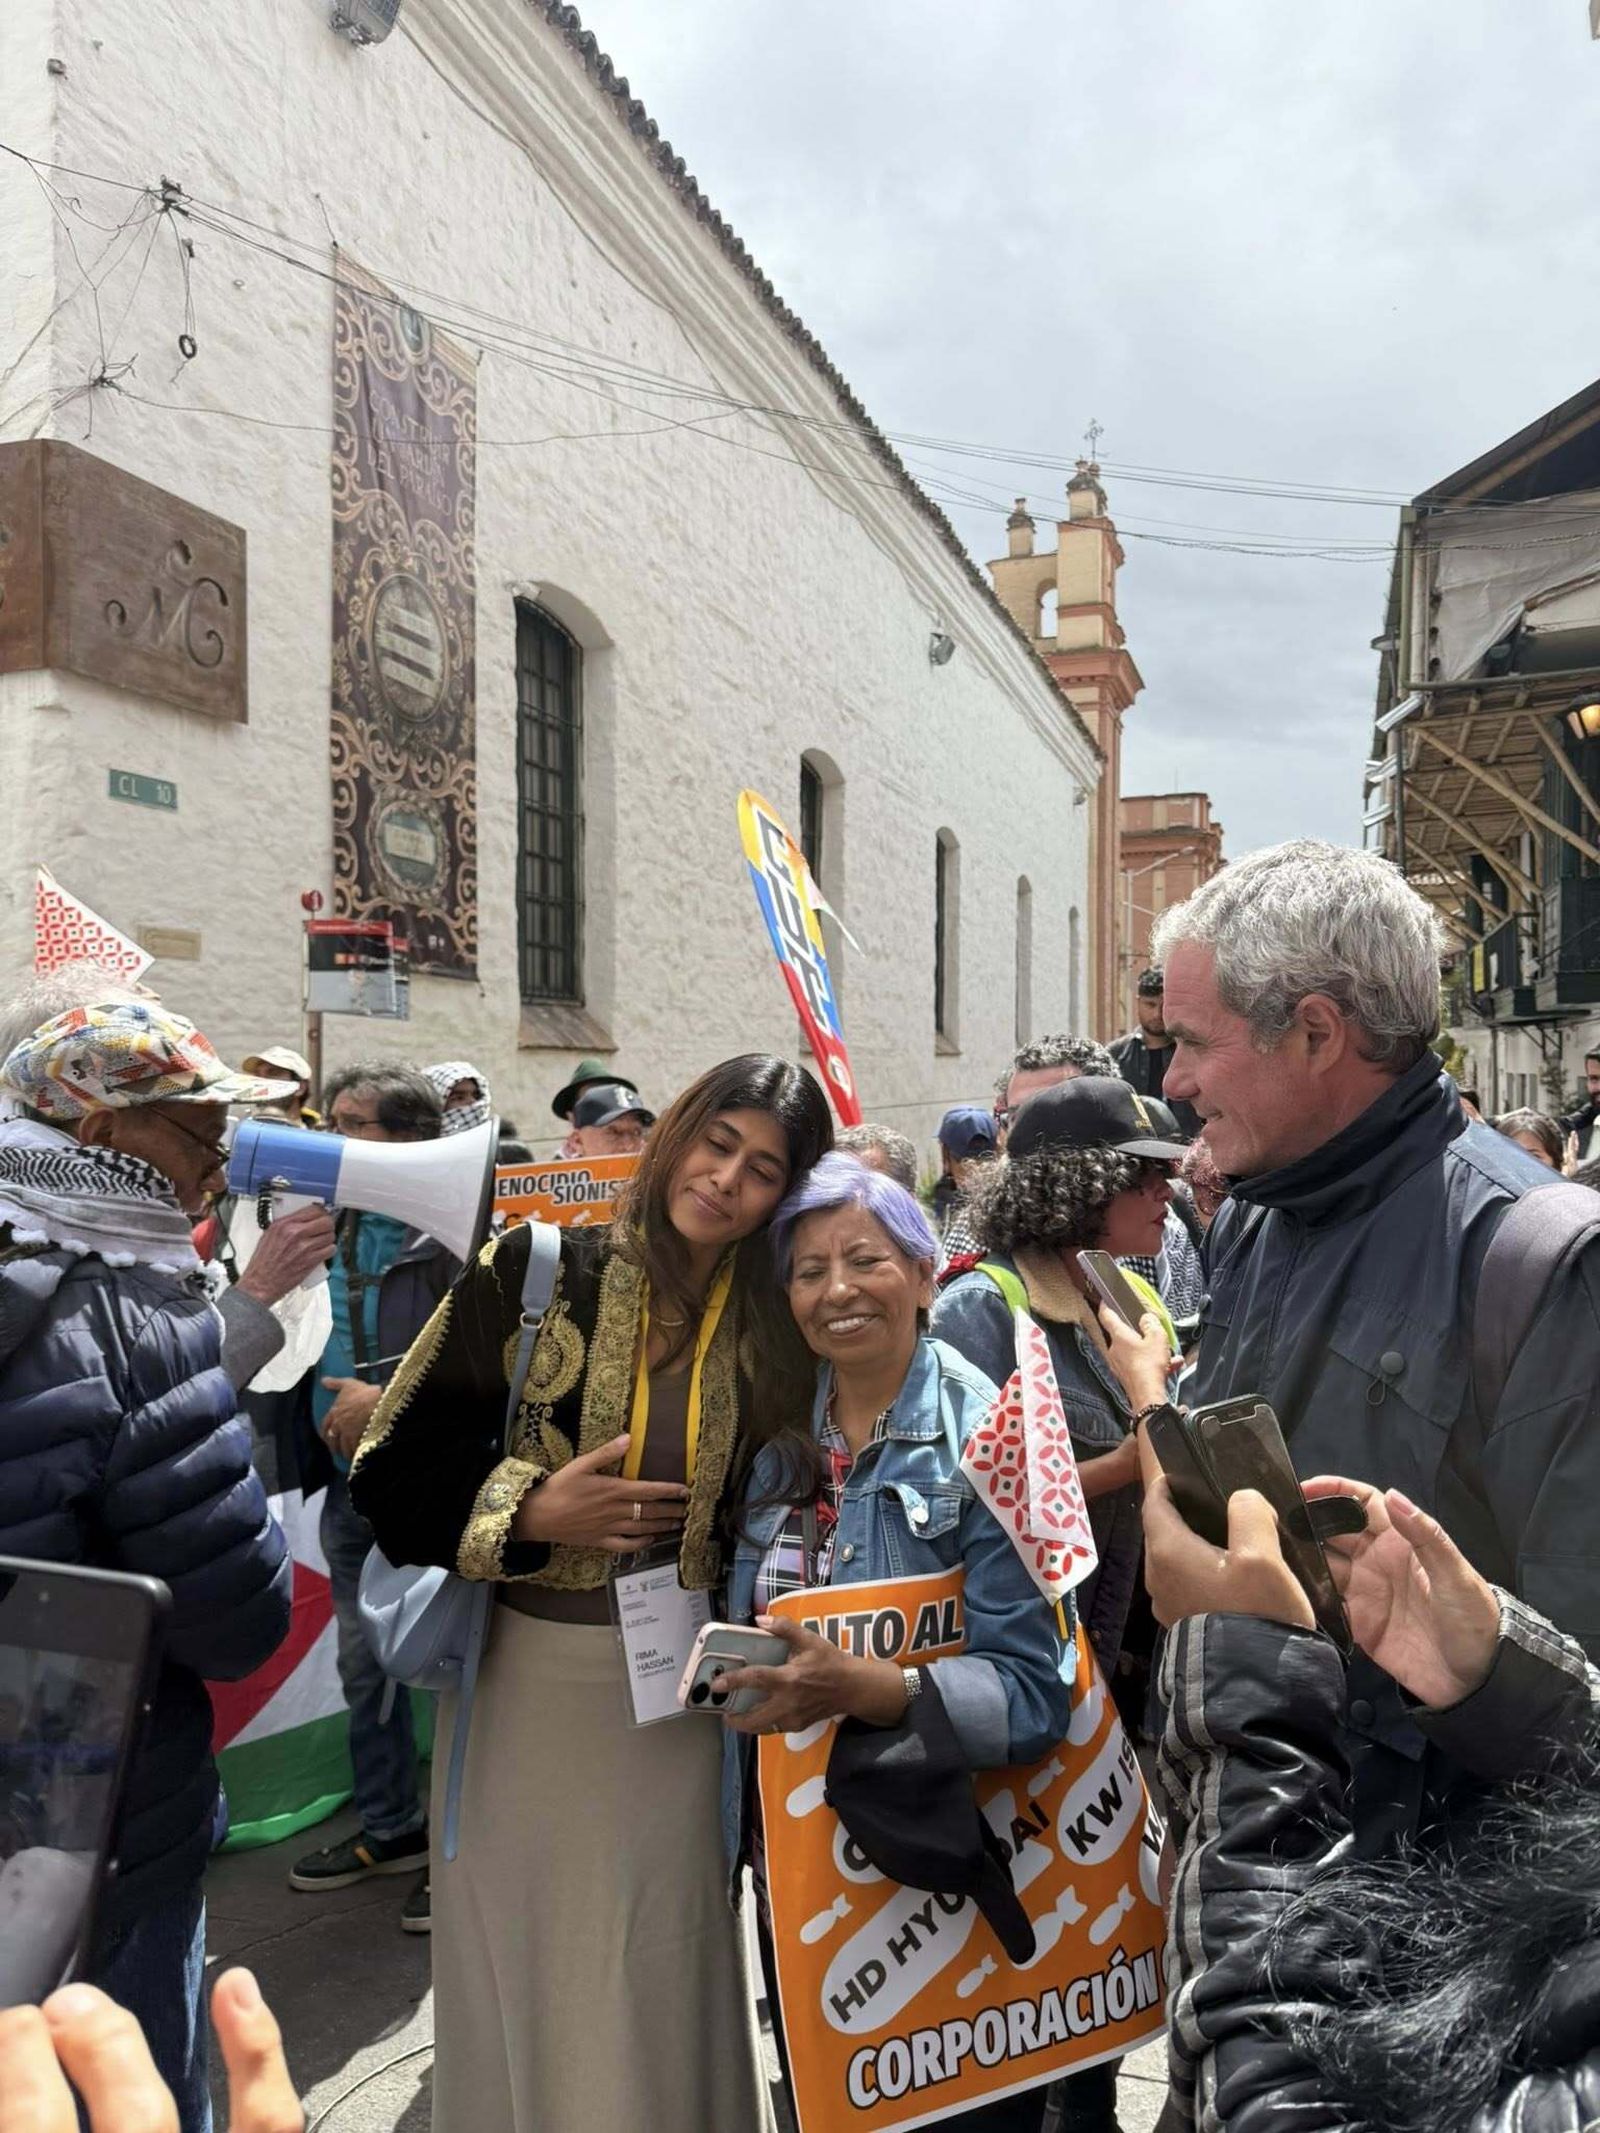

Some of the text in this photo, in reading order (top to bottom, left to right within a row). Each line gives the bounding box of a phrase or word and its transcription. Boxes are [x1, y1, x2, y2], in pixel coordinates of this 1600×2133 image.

[119, 775, 139, 798] CL
[496, 1170, 591, 1198] ENOCIDIO
[553, 1180, 627, 1205] SIONIS
[911, 1599, 965, 1652] AL
[1064, 1771, 1123, 1858] KW
[830, 1959, 888, 2024] HD
[847, 1944, 1160, 2110] CORPORACIÓN
